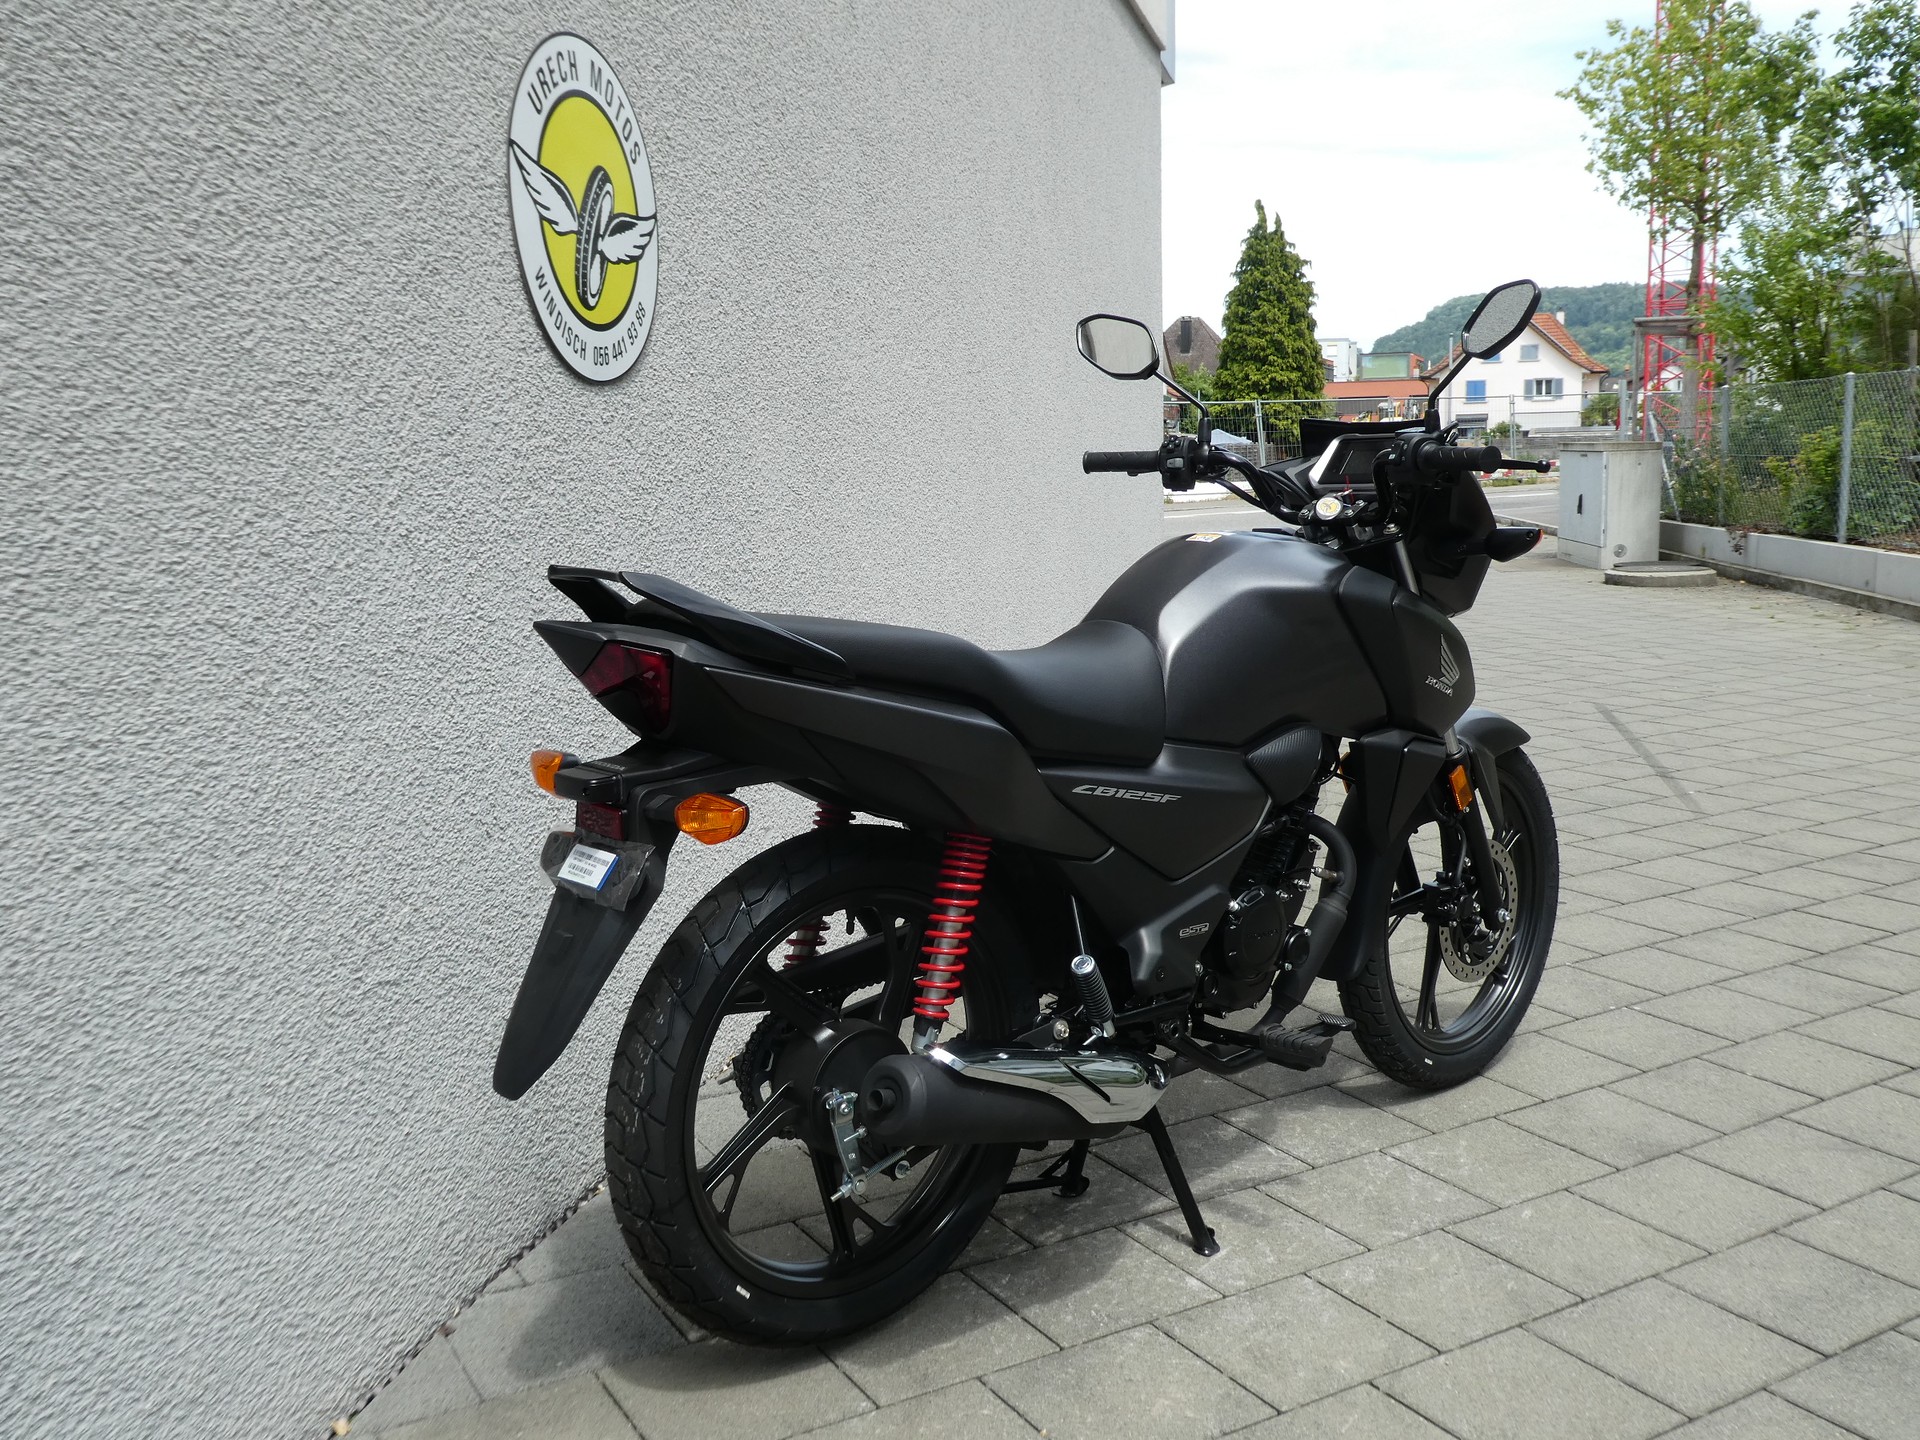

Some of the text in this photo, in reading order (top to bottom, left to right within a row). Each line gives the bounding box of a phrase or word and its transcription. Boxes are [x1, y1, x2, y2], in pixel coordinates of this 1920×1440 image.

[527, 50, 641, 165] URECH MOTOS
[535, 266, 646, 366] WINDISCH 056 441 93 88
[1072, 784, 1182, 803] CB125F
